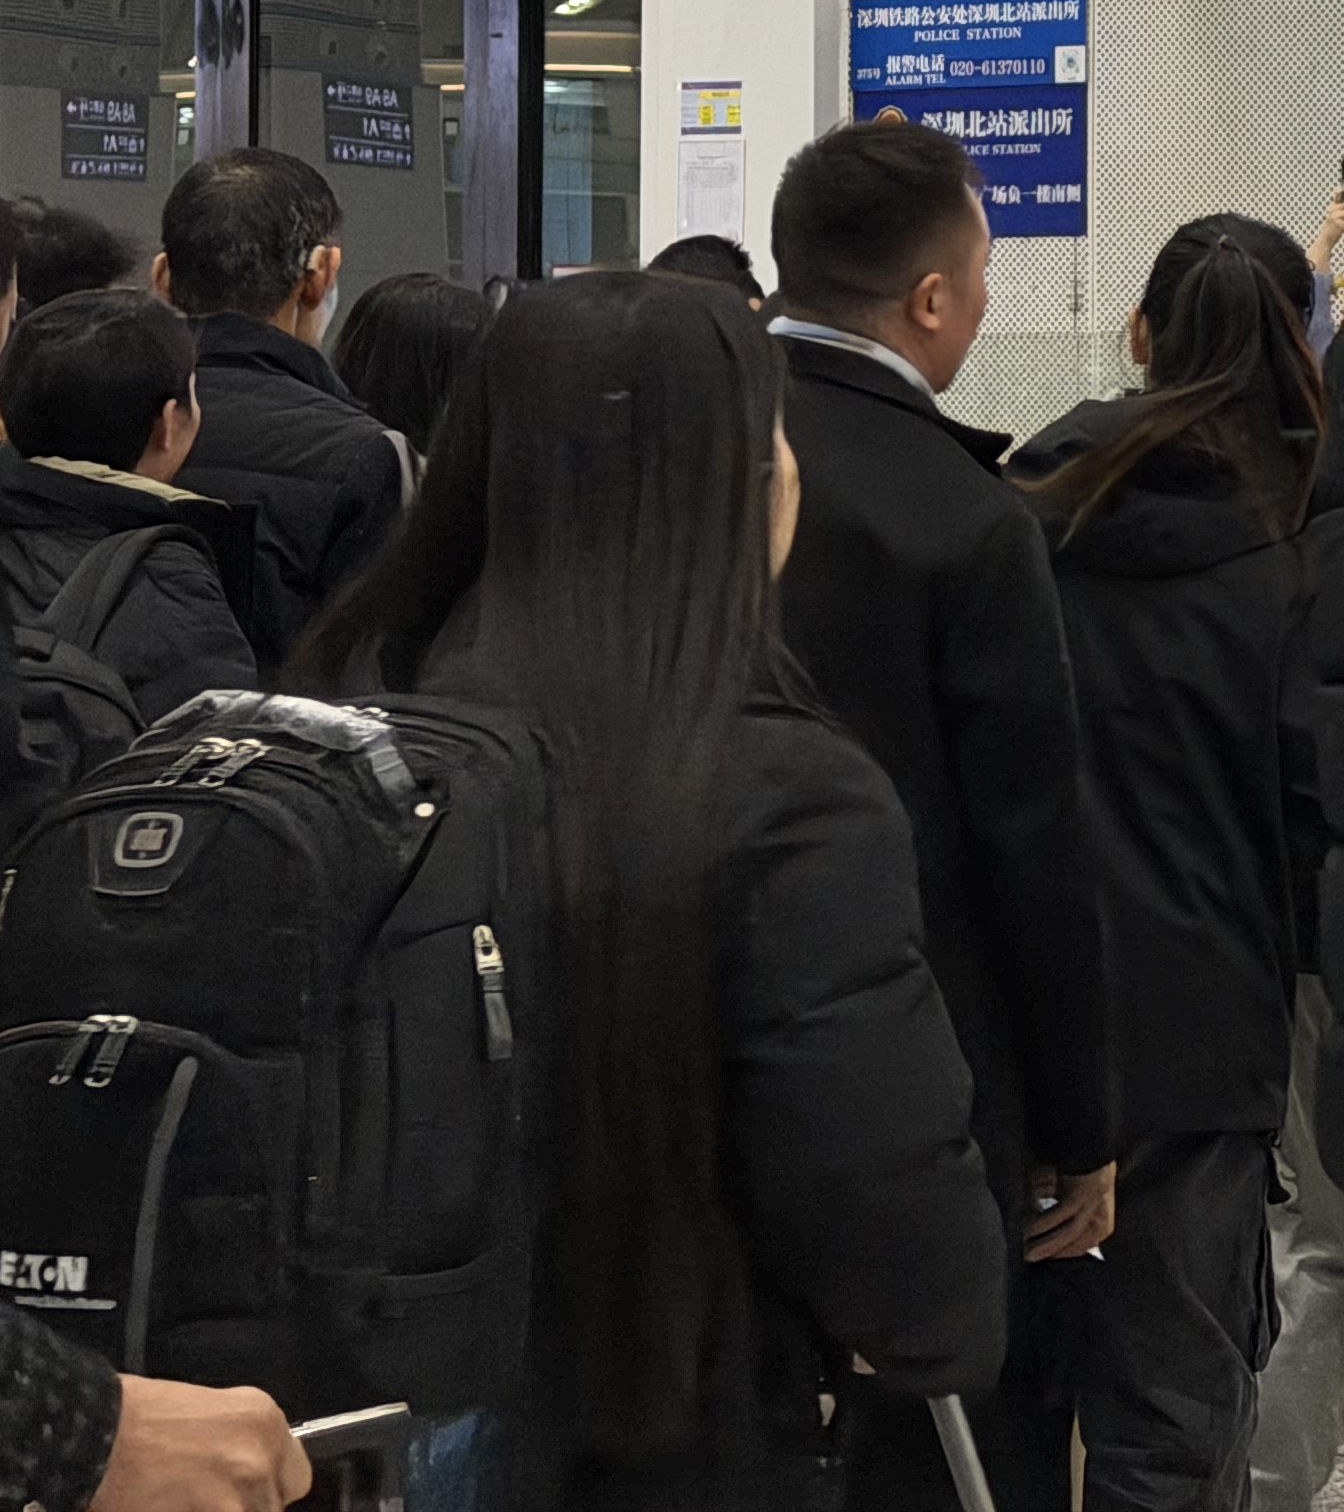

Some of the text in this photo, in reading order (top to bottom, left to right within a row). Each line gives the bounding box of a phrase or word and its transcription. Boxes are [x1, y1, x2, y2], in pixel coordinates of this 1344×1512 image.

[857, 0, 1080, 29] 深圳铁路公安处深圳北站派出所
[914, 26, 1022, 43] POLICE STATION
[886, 54, 946, 75] 报警电话
[949, 58, 1046, 77] 020-61370110
[885, 73, 946, 86] ALARM TEL
[992, 143, 1042, 155] STATION
